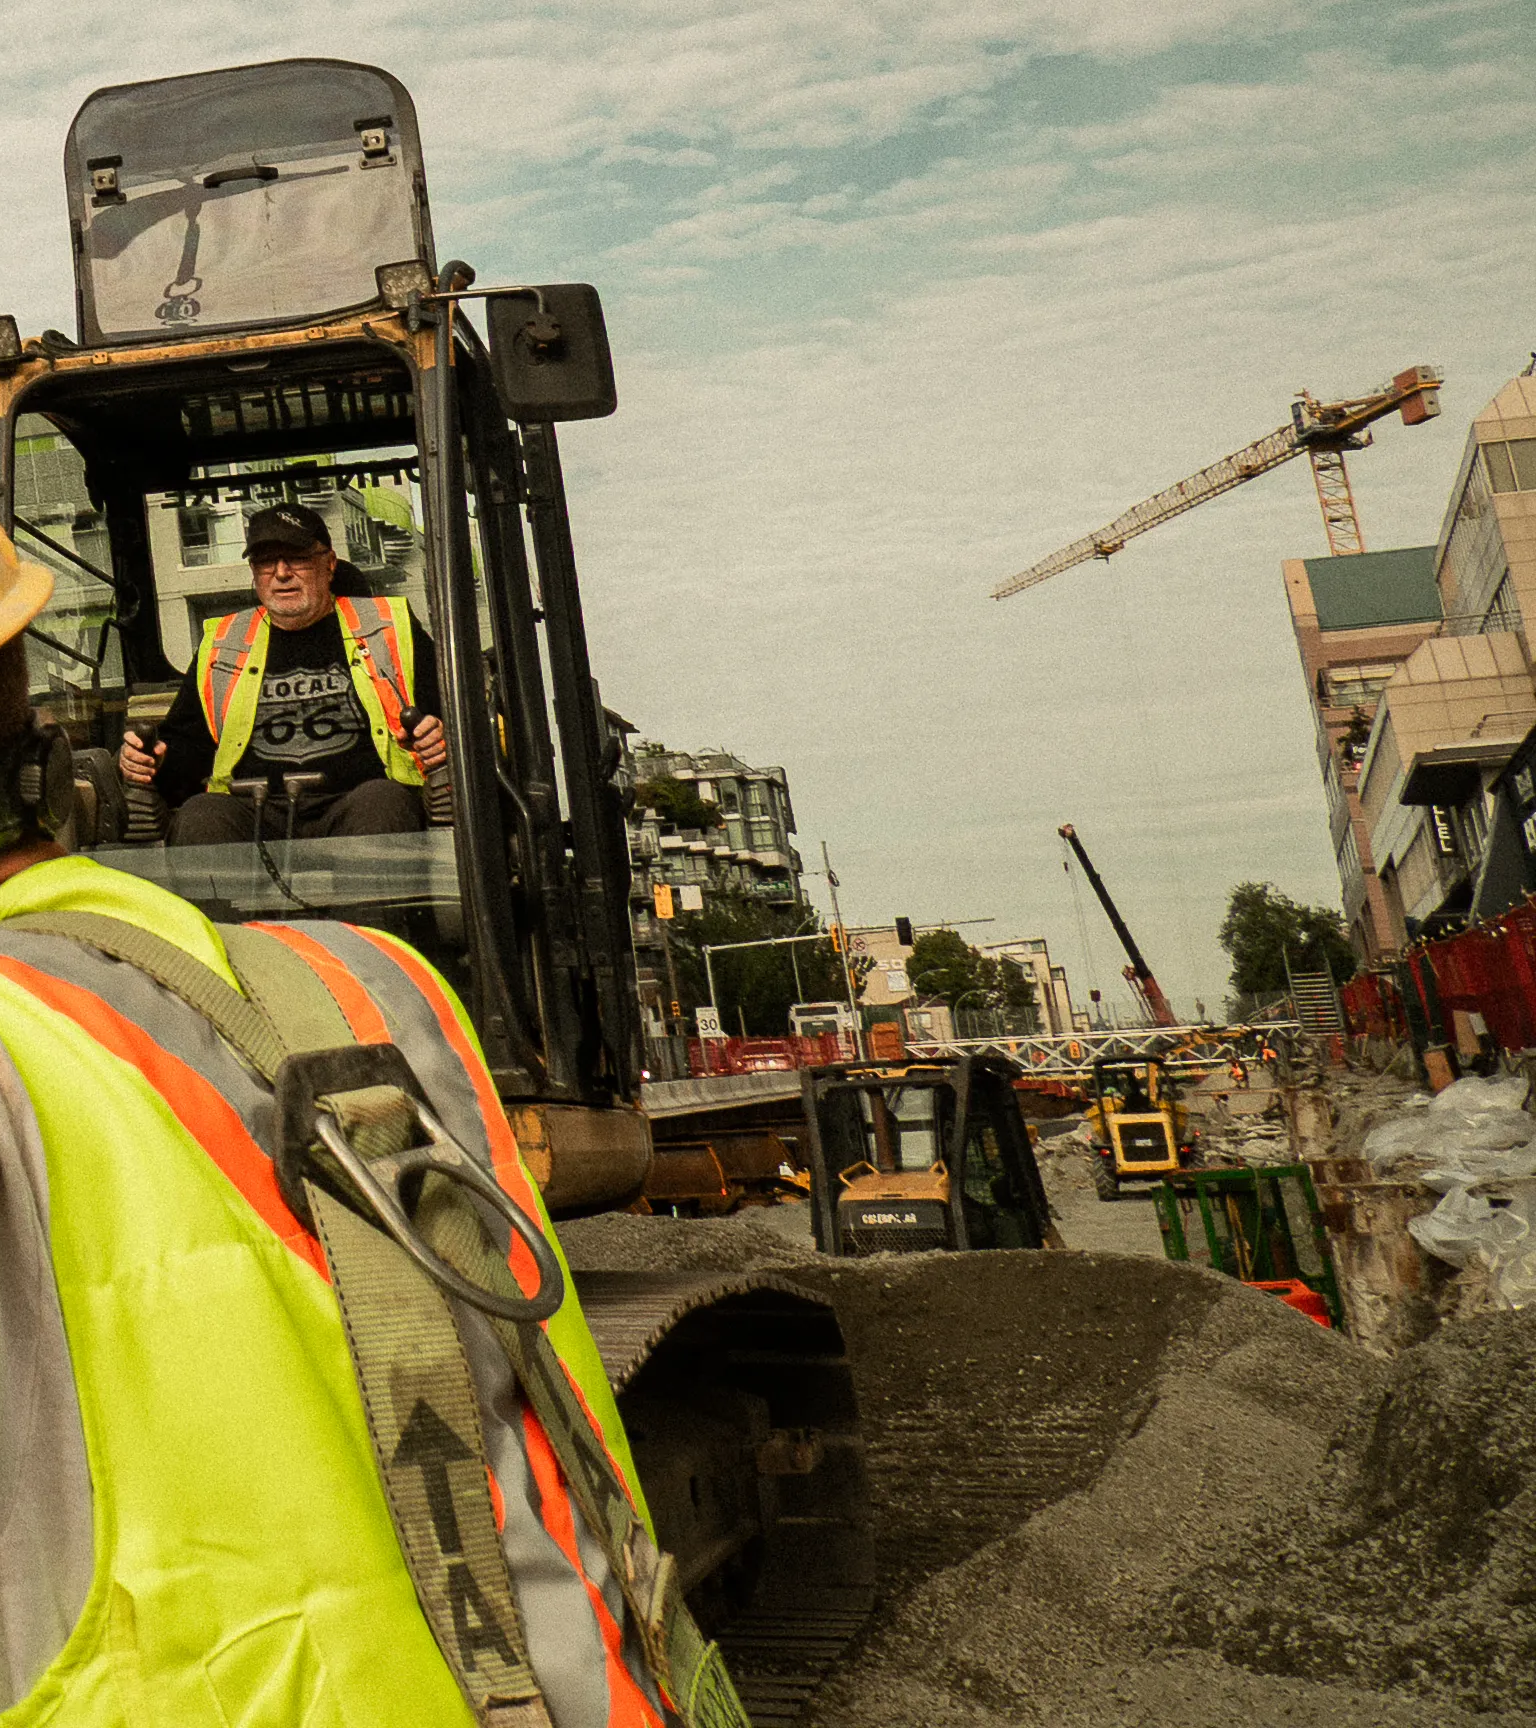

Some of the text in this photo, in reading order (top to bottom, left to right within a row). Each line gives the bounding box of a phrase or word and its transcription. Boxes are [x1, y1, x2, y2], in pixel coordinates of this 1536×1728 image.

[263, 675, 339, 699] LOCAL
[263, 704, 343, 746] 66
[700, 1018, 717, 1031] 30
